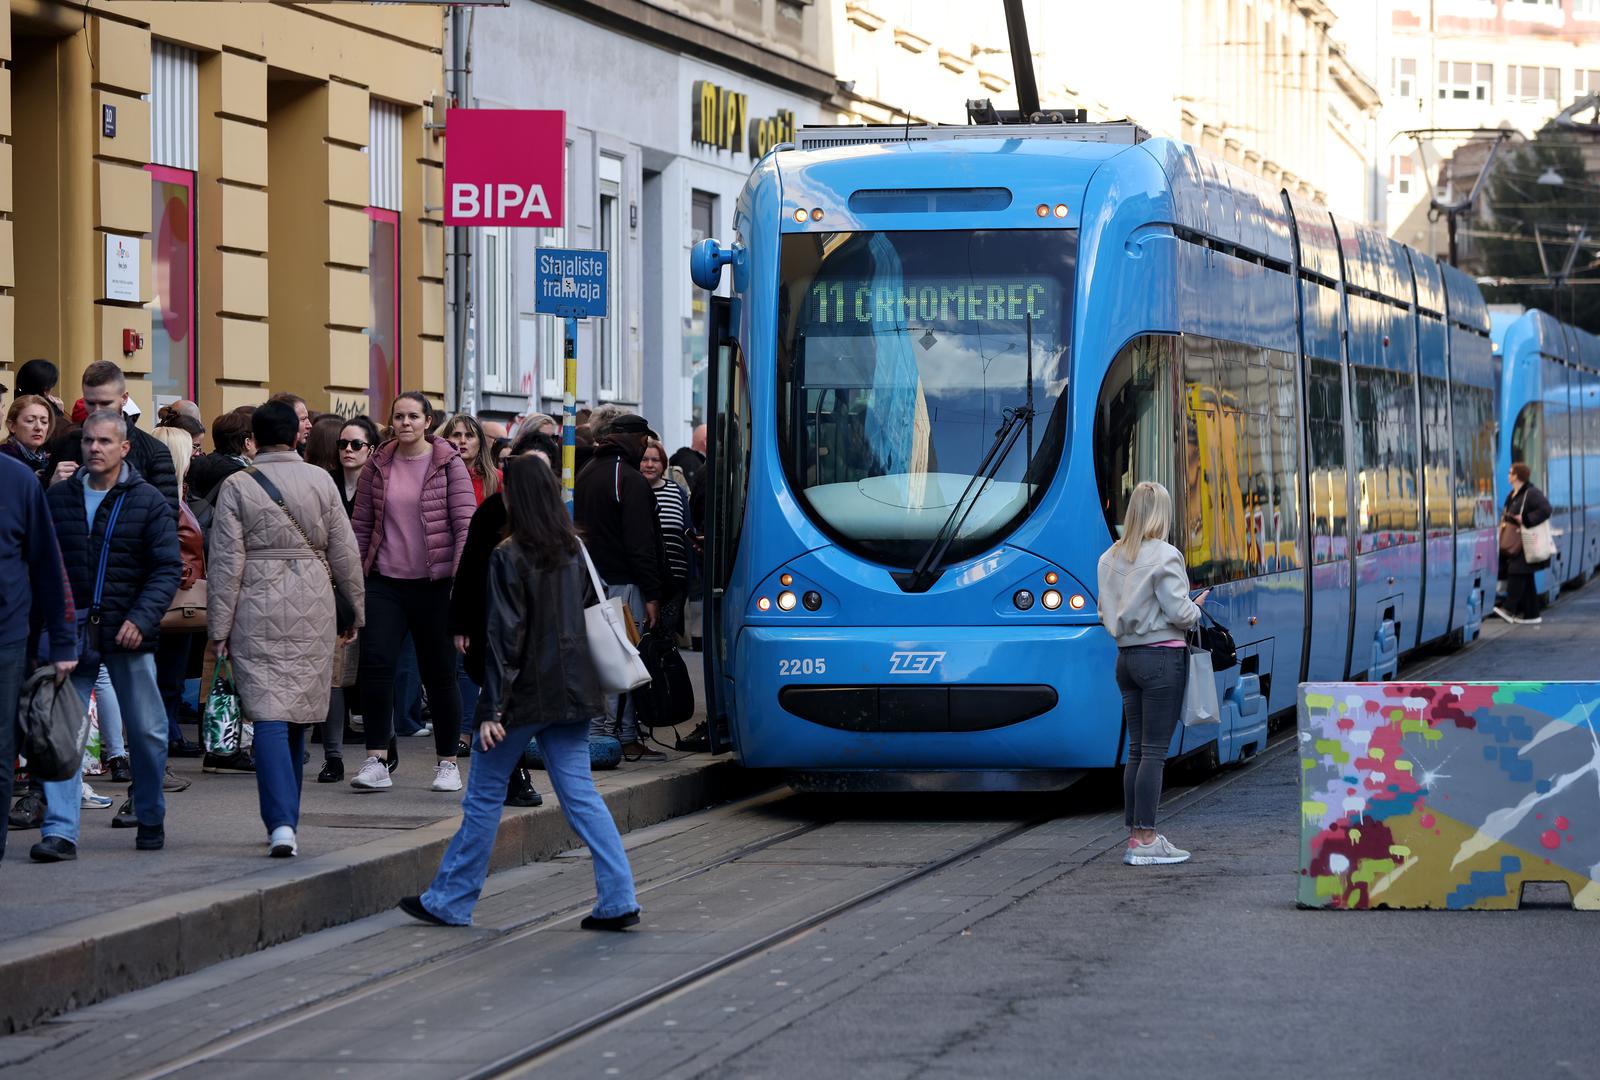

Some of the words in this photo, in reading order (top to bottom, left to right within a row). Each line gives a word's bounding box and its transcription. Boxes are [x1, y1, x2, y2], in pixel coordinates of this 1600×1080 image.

[452, 183, 552, 219] BIPA
[541, 255, 602, 277] Stajalište
[813, 281, 844, 322] 11
[779, 658, 826, 676] 2205
[889, 651, 947, 674] ZET
